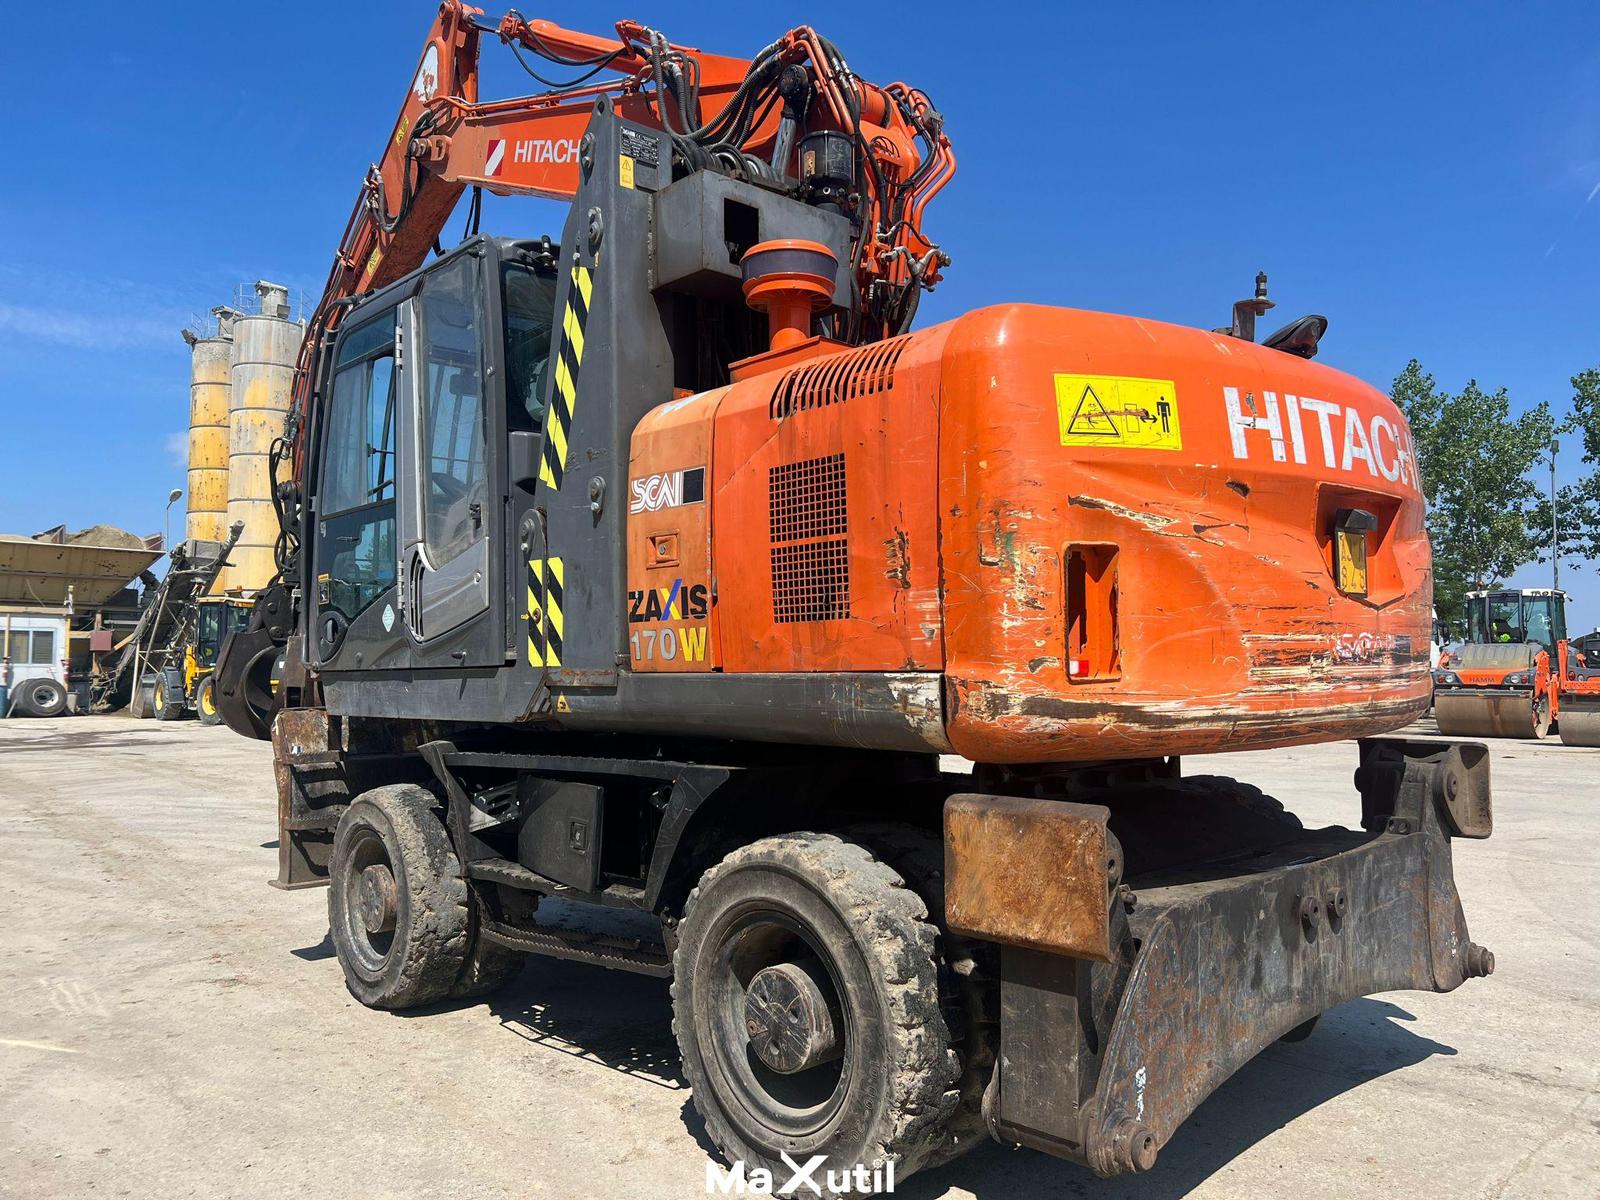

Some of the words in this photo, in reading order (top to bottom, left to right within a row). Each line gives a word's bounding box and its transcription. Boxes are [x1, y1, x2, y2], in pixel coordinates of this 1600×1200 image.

[513, 139, 582, 163] HITACH
[1223, 386, 1422, 493] HITACHI
[629, 578, 708, 623] ZAXIS
[631, 626, 707, 661] 170W
